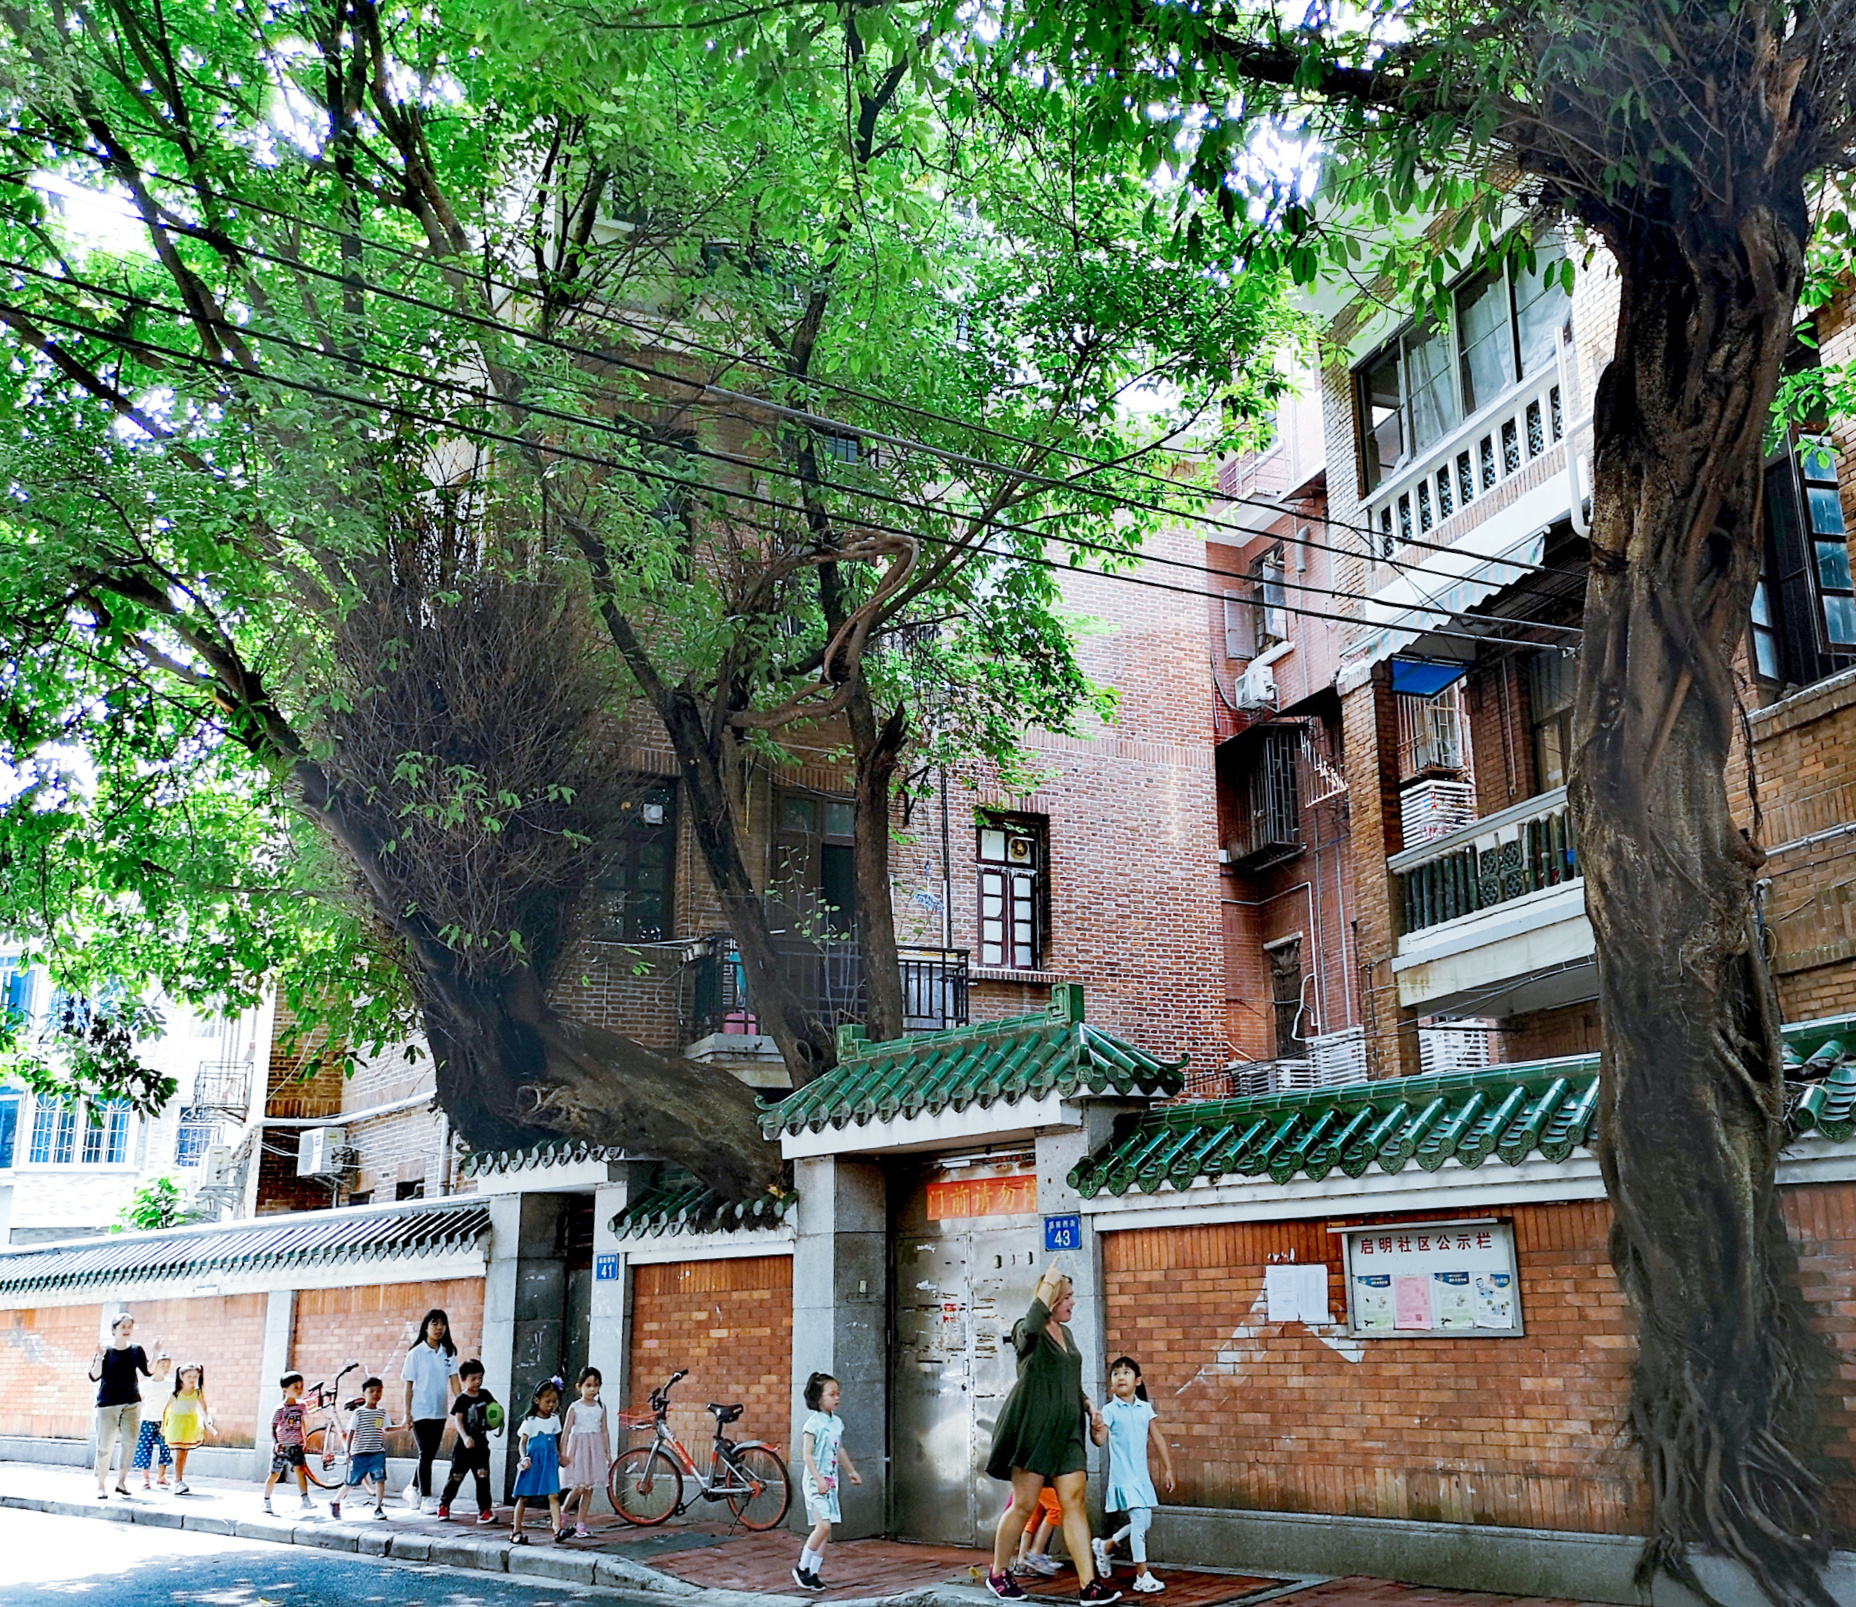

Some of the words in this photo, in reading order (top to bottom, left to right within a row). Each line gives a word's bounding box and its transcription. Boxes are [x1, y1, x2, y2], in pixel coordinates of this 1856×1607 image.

[1054, 1229, 1071, 1246] 43
[1360, 1232, 1493, 1254] 启明社区公示栏
[601, 1264, 613, 1278] 41
